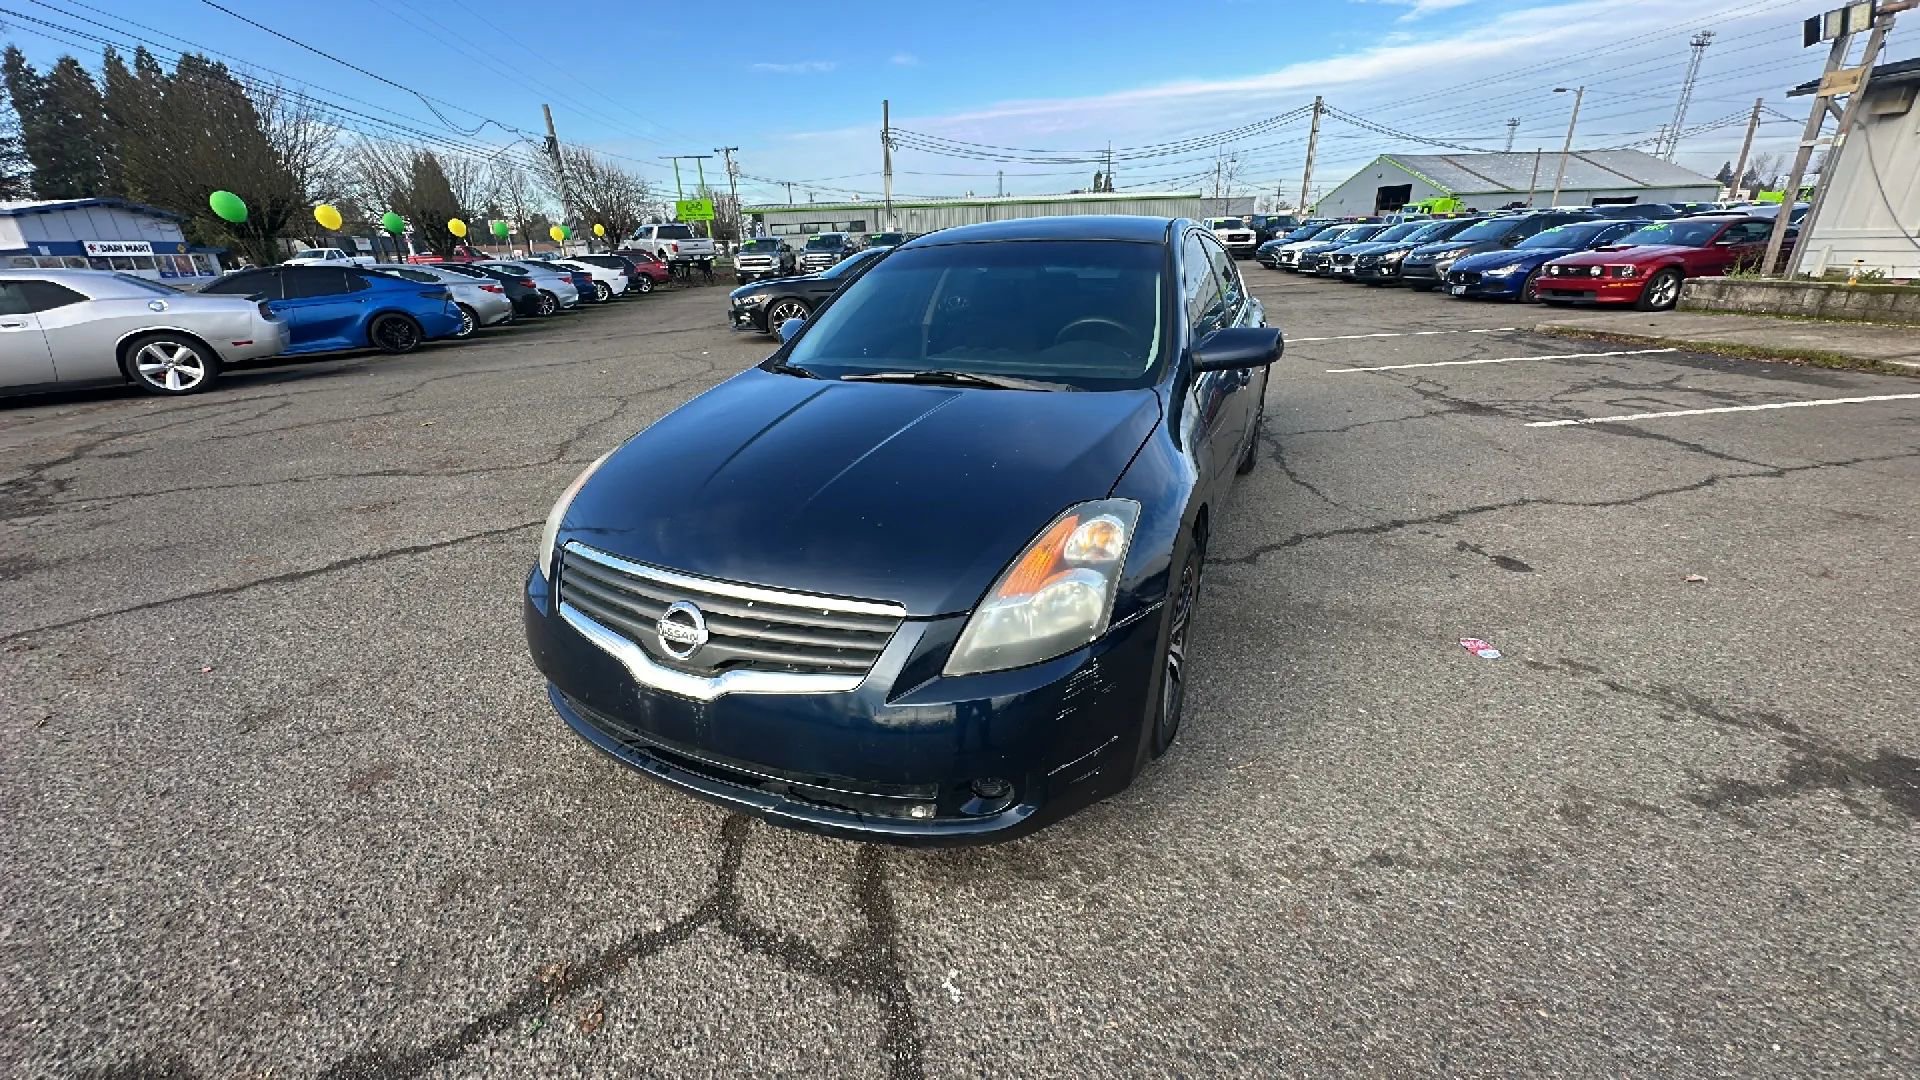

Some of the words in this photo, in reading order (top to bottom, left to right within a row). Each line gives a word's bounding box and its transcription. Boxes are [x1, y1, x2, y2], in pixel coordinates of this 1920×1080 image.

[100, 244, 124, 253] DARI
[124, 244, 150, 253] MART
[658, 623, 699, 641] NISSAN
